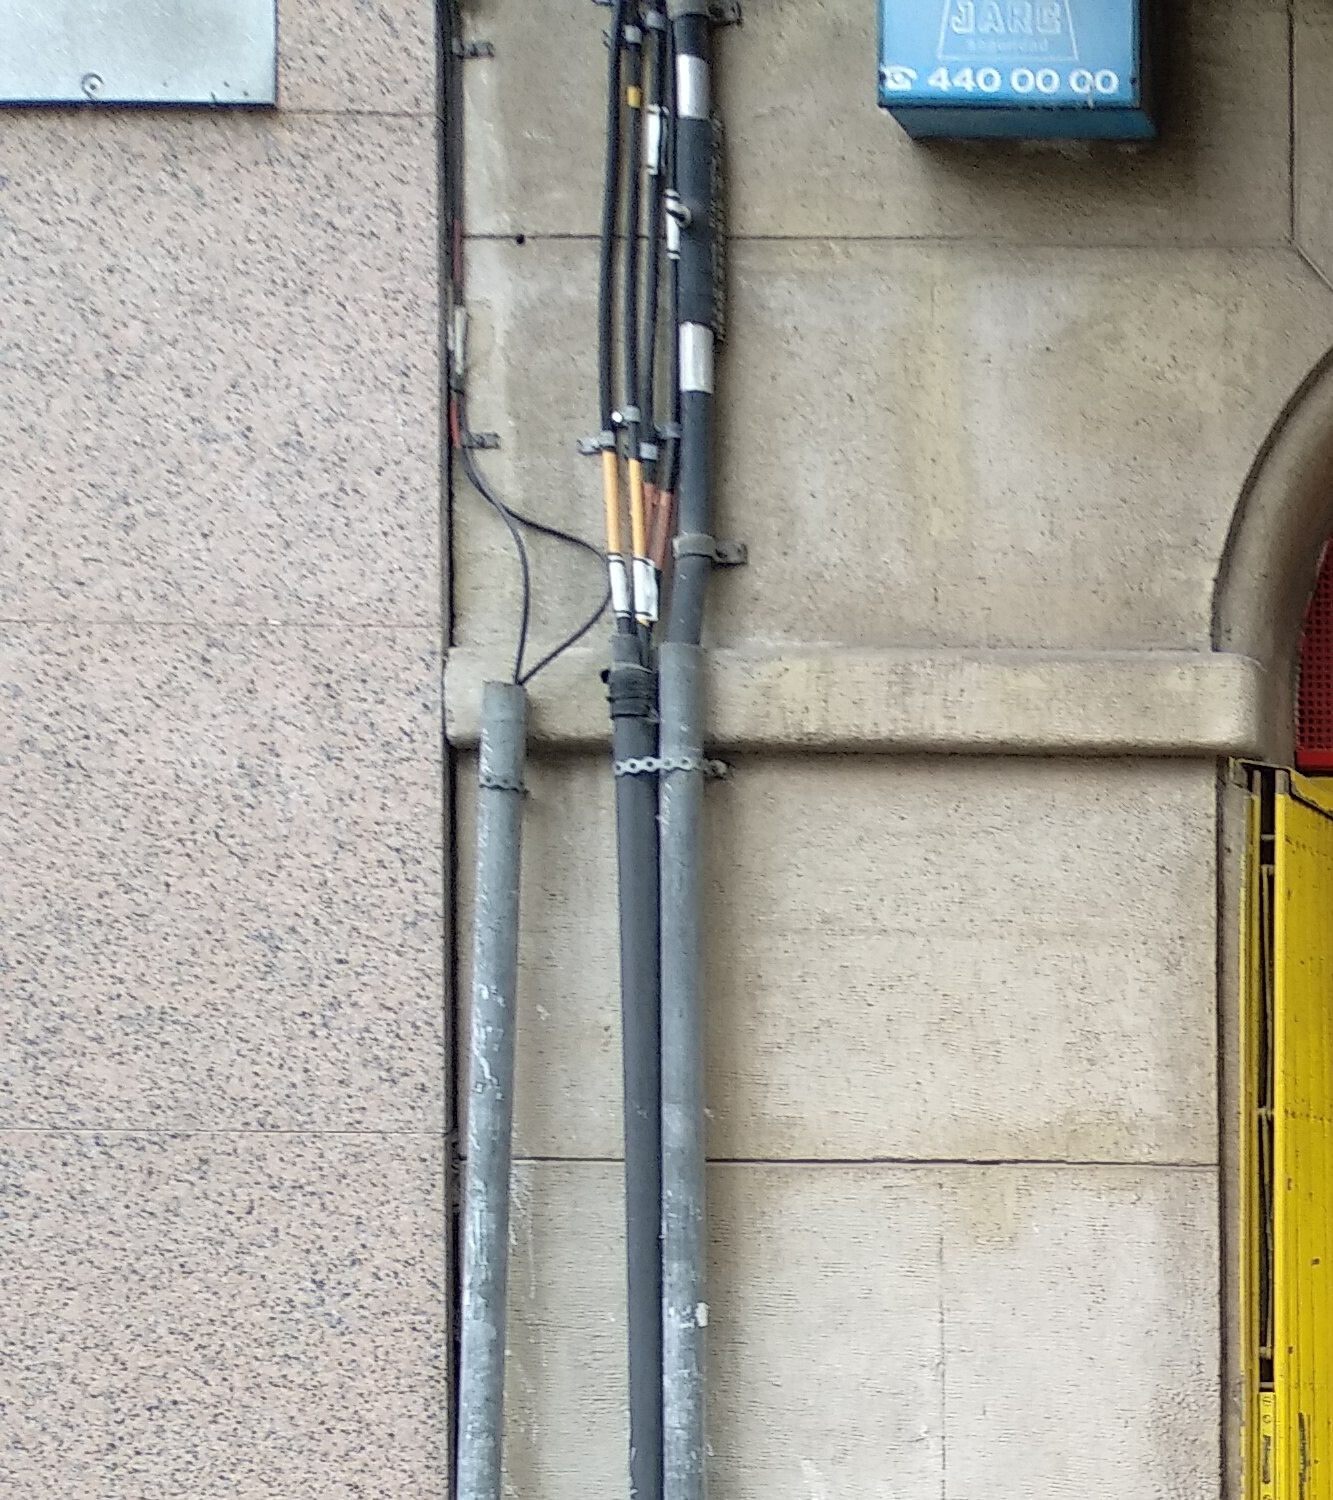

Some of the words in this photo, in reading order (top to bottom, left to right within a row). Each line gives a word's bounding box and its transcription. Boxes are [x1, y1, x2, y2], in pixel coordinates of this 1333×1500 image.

[928, 66, 1001, 93] 440
[1010, 67, 1060, 94] 00
[1069, 68, 1120, 95] 00
